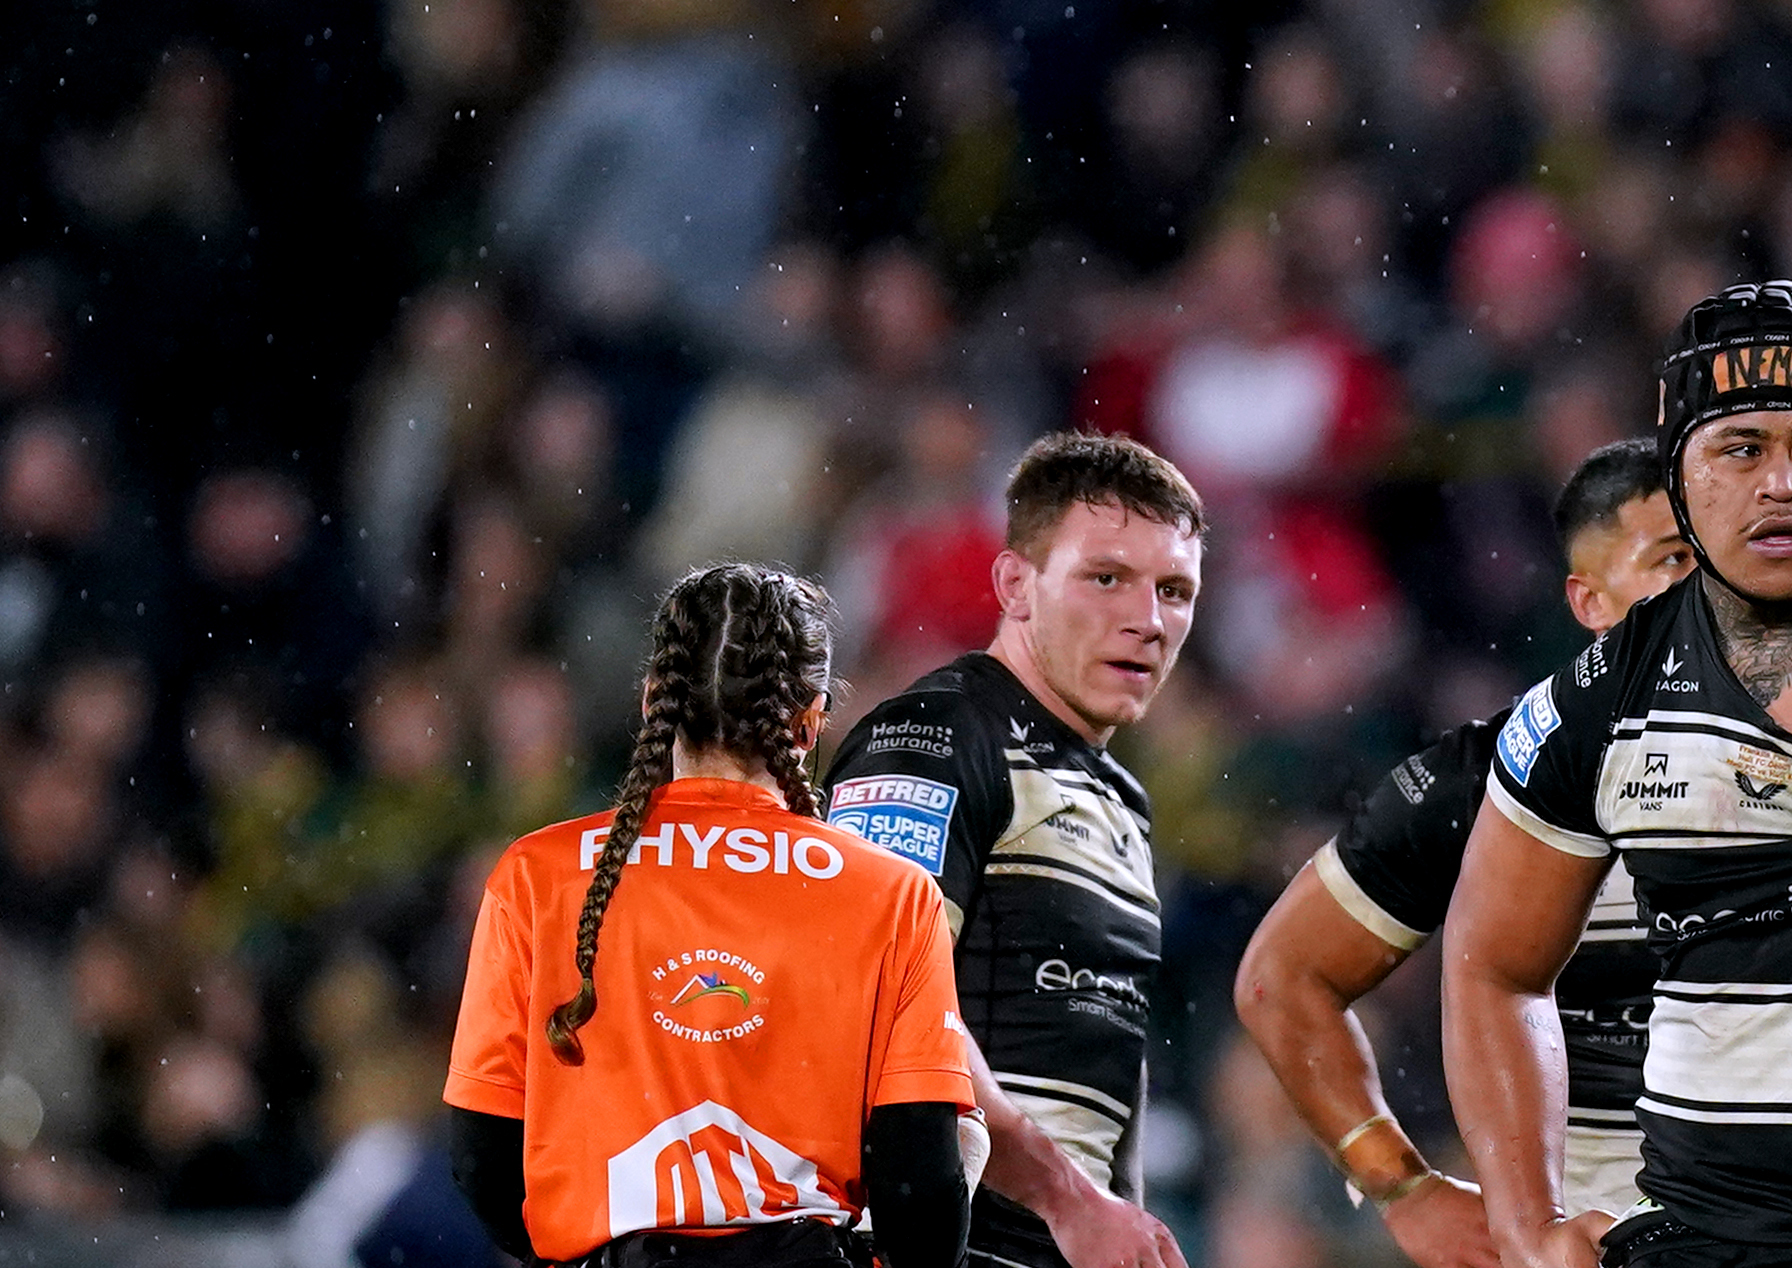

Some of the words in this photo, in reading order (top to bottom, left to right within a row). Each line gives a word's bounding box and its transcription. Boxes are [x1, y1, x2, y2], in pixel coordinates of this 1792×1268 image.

[872, 719, 934, 739] Hedon
[835, 781, 950, 810] BETFRED
[1639, 802, 1663, 811] VANS
[869, 814, 941, 846] SUPER
[579, 823, 845, 880] PHYSIO
[865, 834, 938, 862] LEAGUE
[652, 966, 666, 981] H
[667, 958, 680, 971] &
[681, 952, 693, 966] S
[696, 949, 766, 985] ROOFING
[652, 1011, 765, 1043] CONTRACTORS
